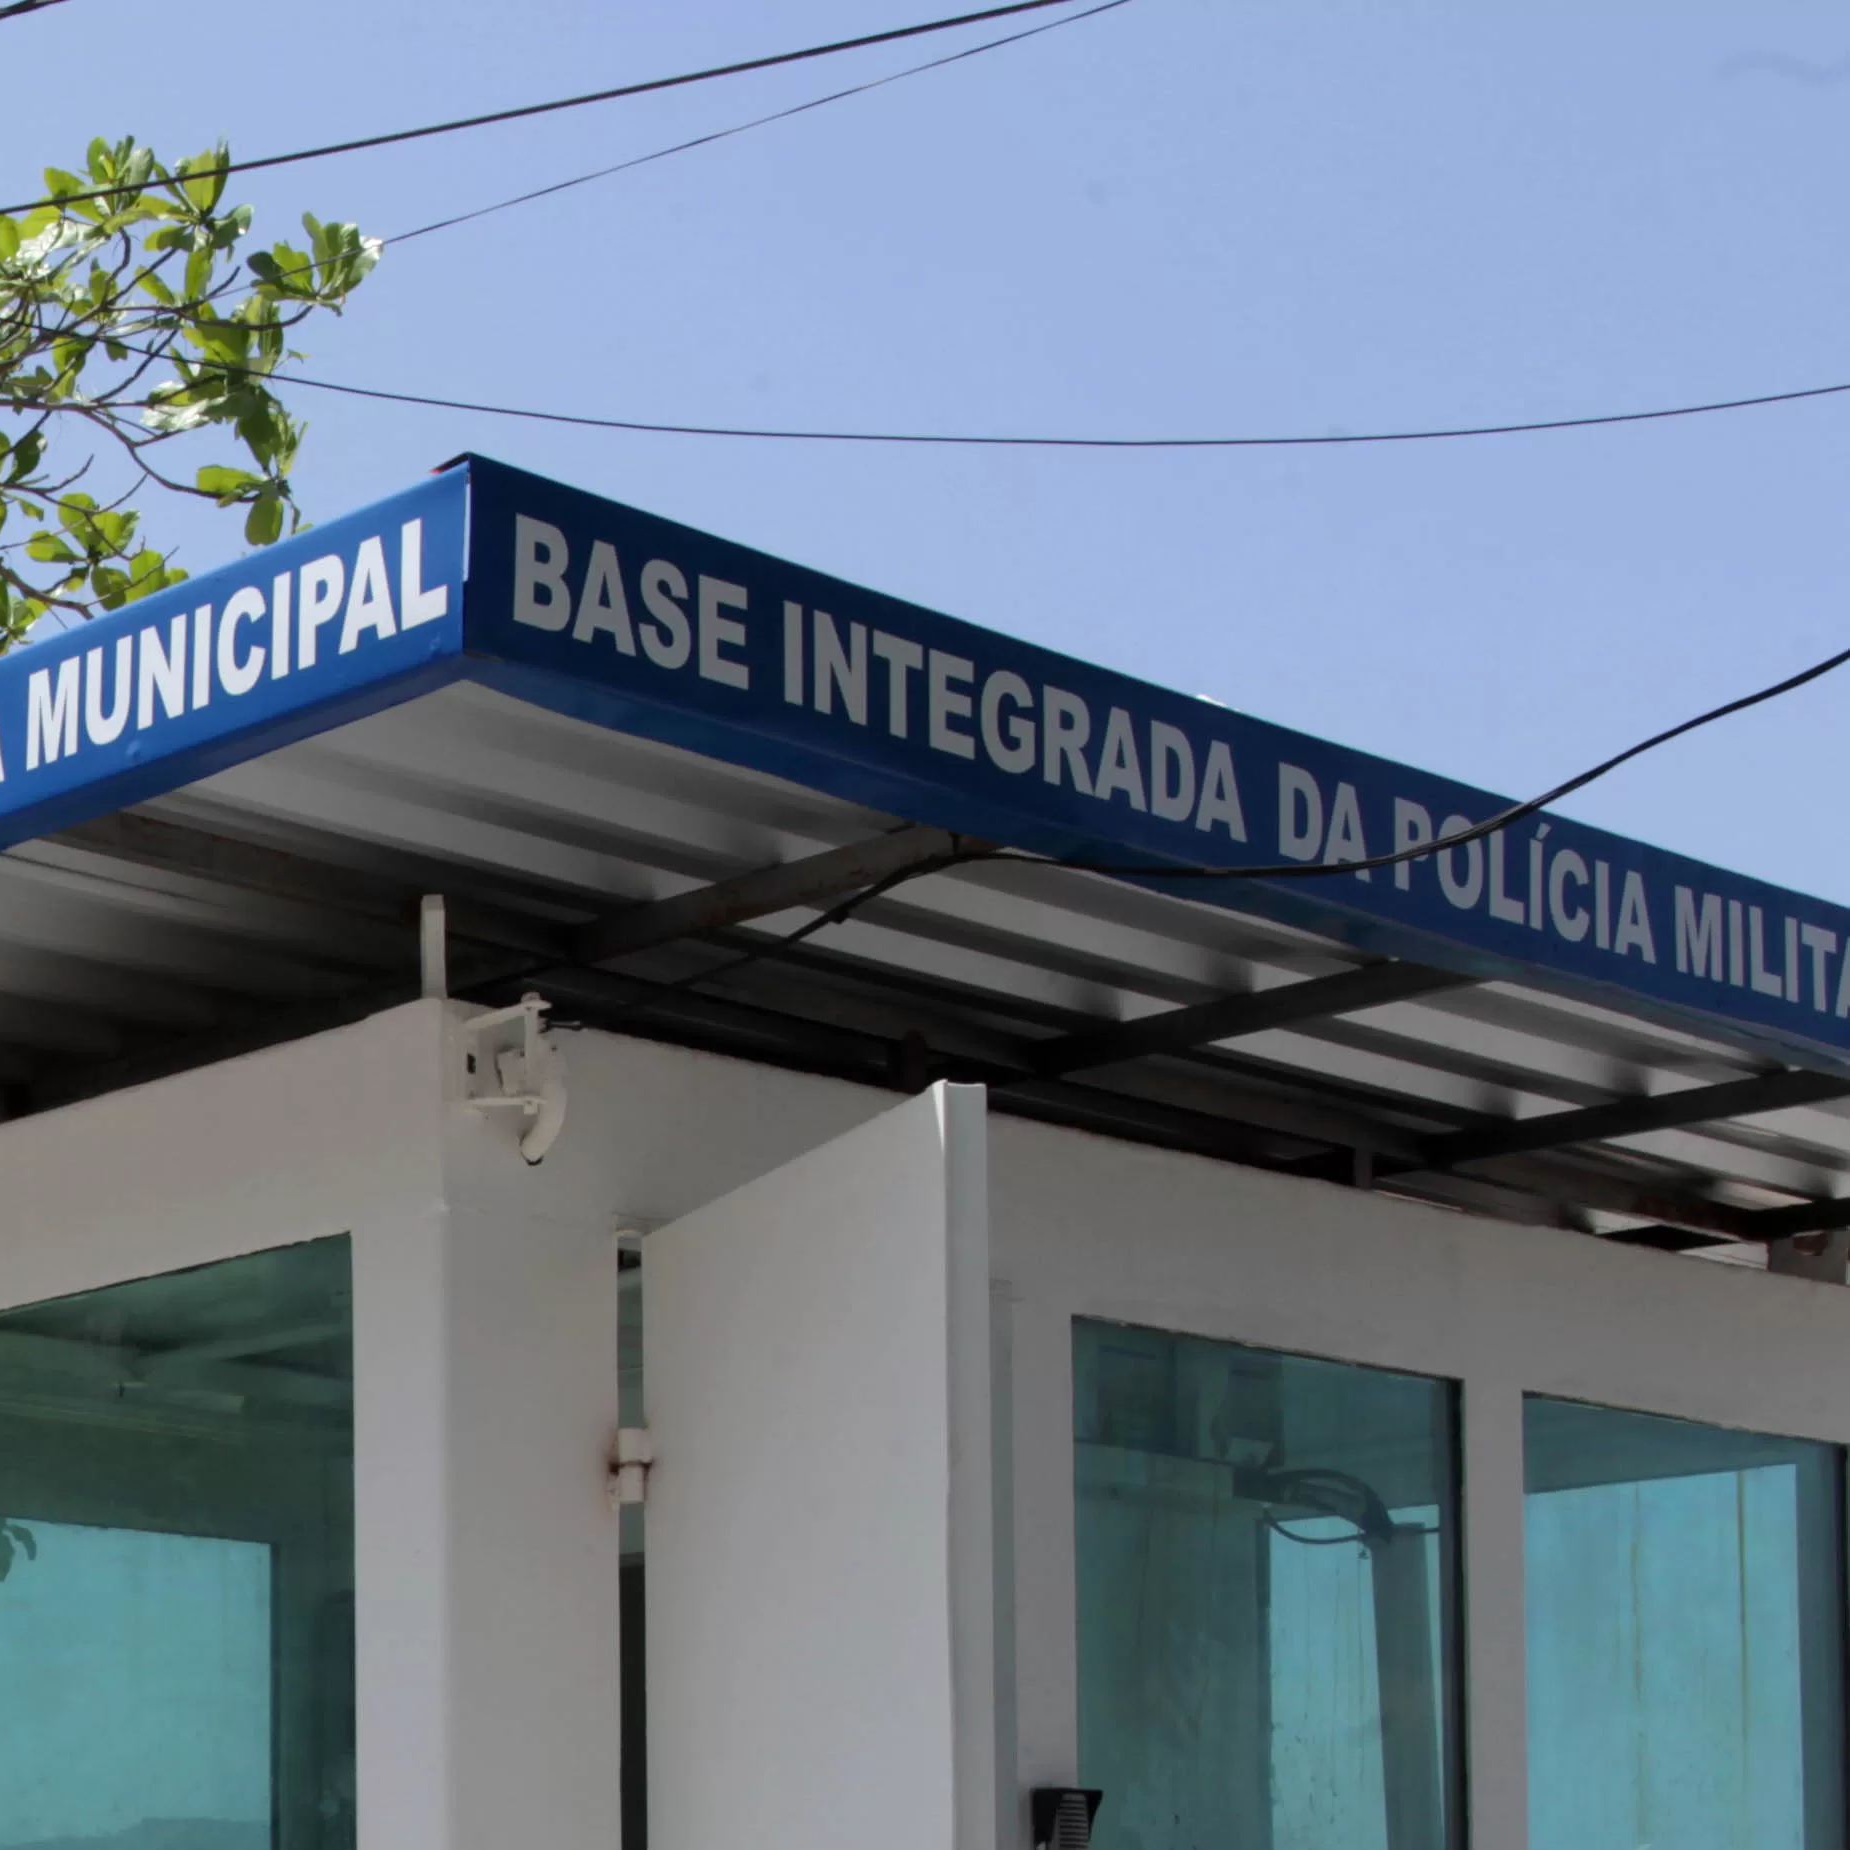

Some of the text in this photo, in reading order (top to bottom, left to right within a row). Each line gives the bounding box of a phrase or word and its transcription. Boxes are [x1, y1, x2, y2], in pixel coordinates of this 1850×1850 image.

[25, 518, 449, 771] MUNICIPAL
[514, 515, 751, 691] BASE
[783, 600, 1246, 842] INTEGRADA
[1279, 762, 1371, 883] DA
[1394, 798, 1656, 965] POLÍCIA
